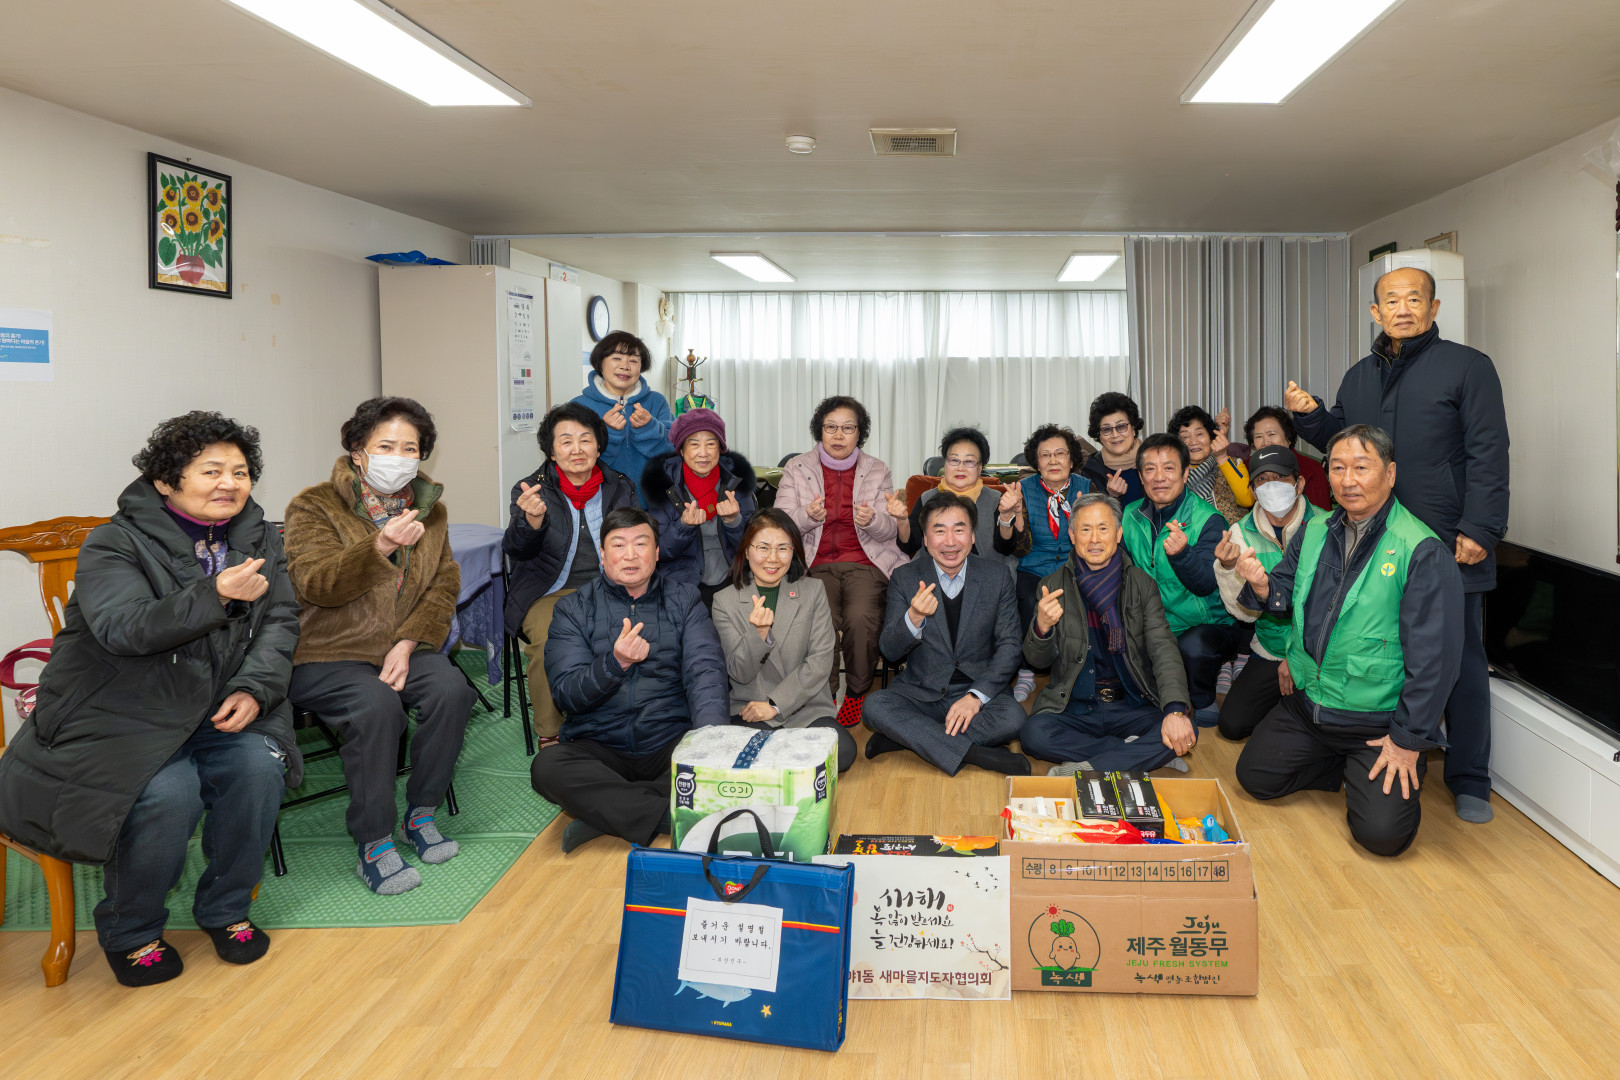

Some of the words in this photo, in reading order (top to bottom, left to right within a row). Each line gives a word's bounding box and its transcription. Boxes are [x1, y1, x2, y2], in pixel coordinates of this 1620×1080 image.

[562, 272, 568, 282] 2
[1025, 864, 1042, 876] 수량
[1049, 864, 1057, 875] 8
[1098, 865, 1108, 876] 11
[1114, 866, 1125, 876] 12
[1131, 866, 1142, 876] 13
[1147, 866, 1159, 876] 14
[1164, 866, 1175, 876] 15
[1180, 866, 1192, 876] 16
[1197, 866, 1209, 876] 17
[880, 888, 945, 910] 새해
[870, 905, 886, 925] 복
[911, 911, 954, 927] 받으세요
[701, 920, 729, 931] 즐거운
[1183, 914, 1220, 936] Jeju
[692, 934, 727, 944] 보내시기
[734, 937, 771, 949] 바랍니다.
[870, 929, 886, 949] 늘
[889, 933, 954, 949] 건강하세요!
[1126, 937, 1166, 956] 제주
[1169, 937, 1228, 957] 월동무
[1126, 960, 1149, 968] JEJU
[1153, 960, 1185, 968] FRESH
[1189, 961, 1228, 969] SYSTEM
[879, 970, 992, 985] 새마을지도자협의회
[1049, 971, 1086, 985] 녹색
[1133, 972, 1163, 984] 녹색
[1166, 974, 1220, 985] 영농조합법인
